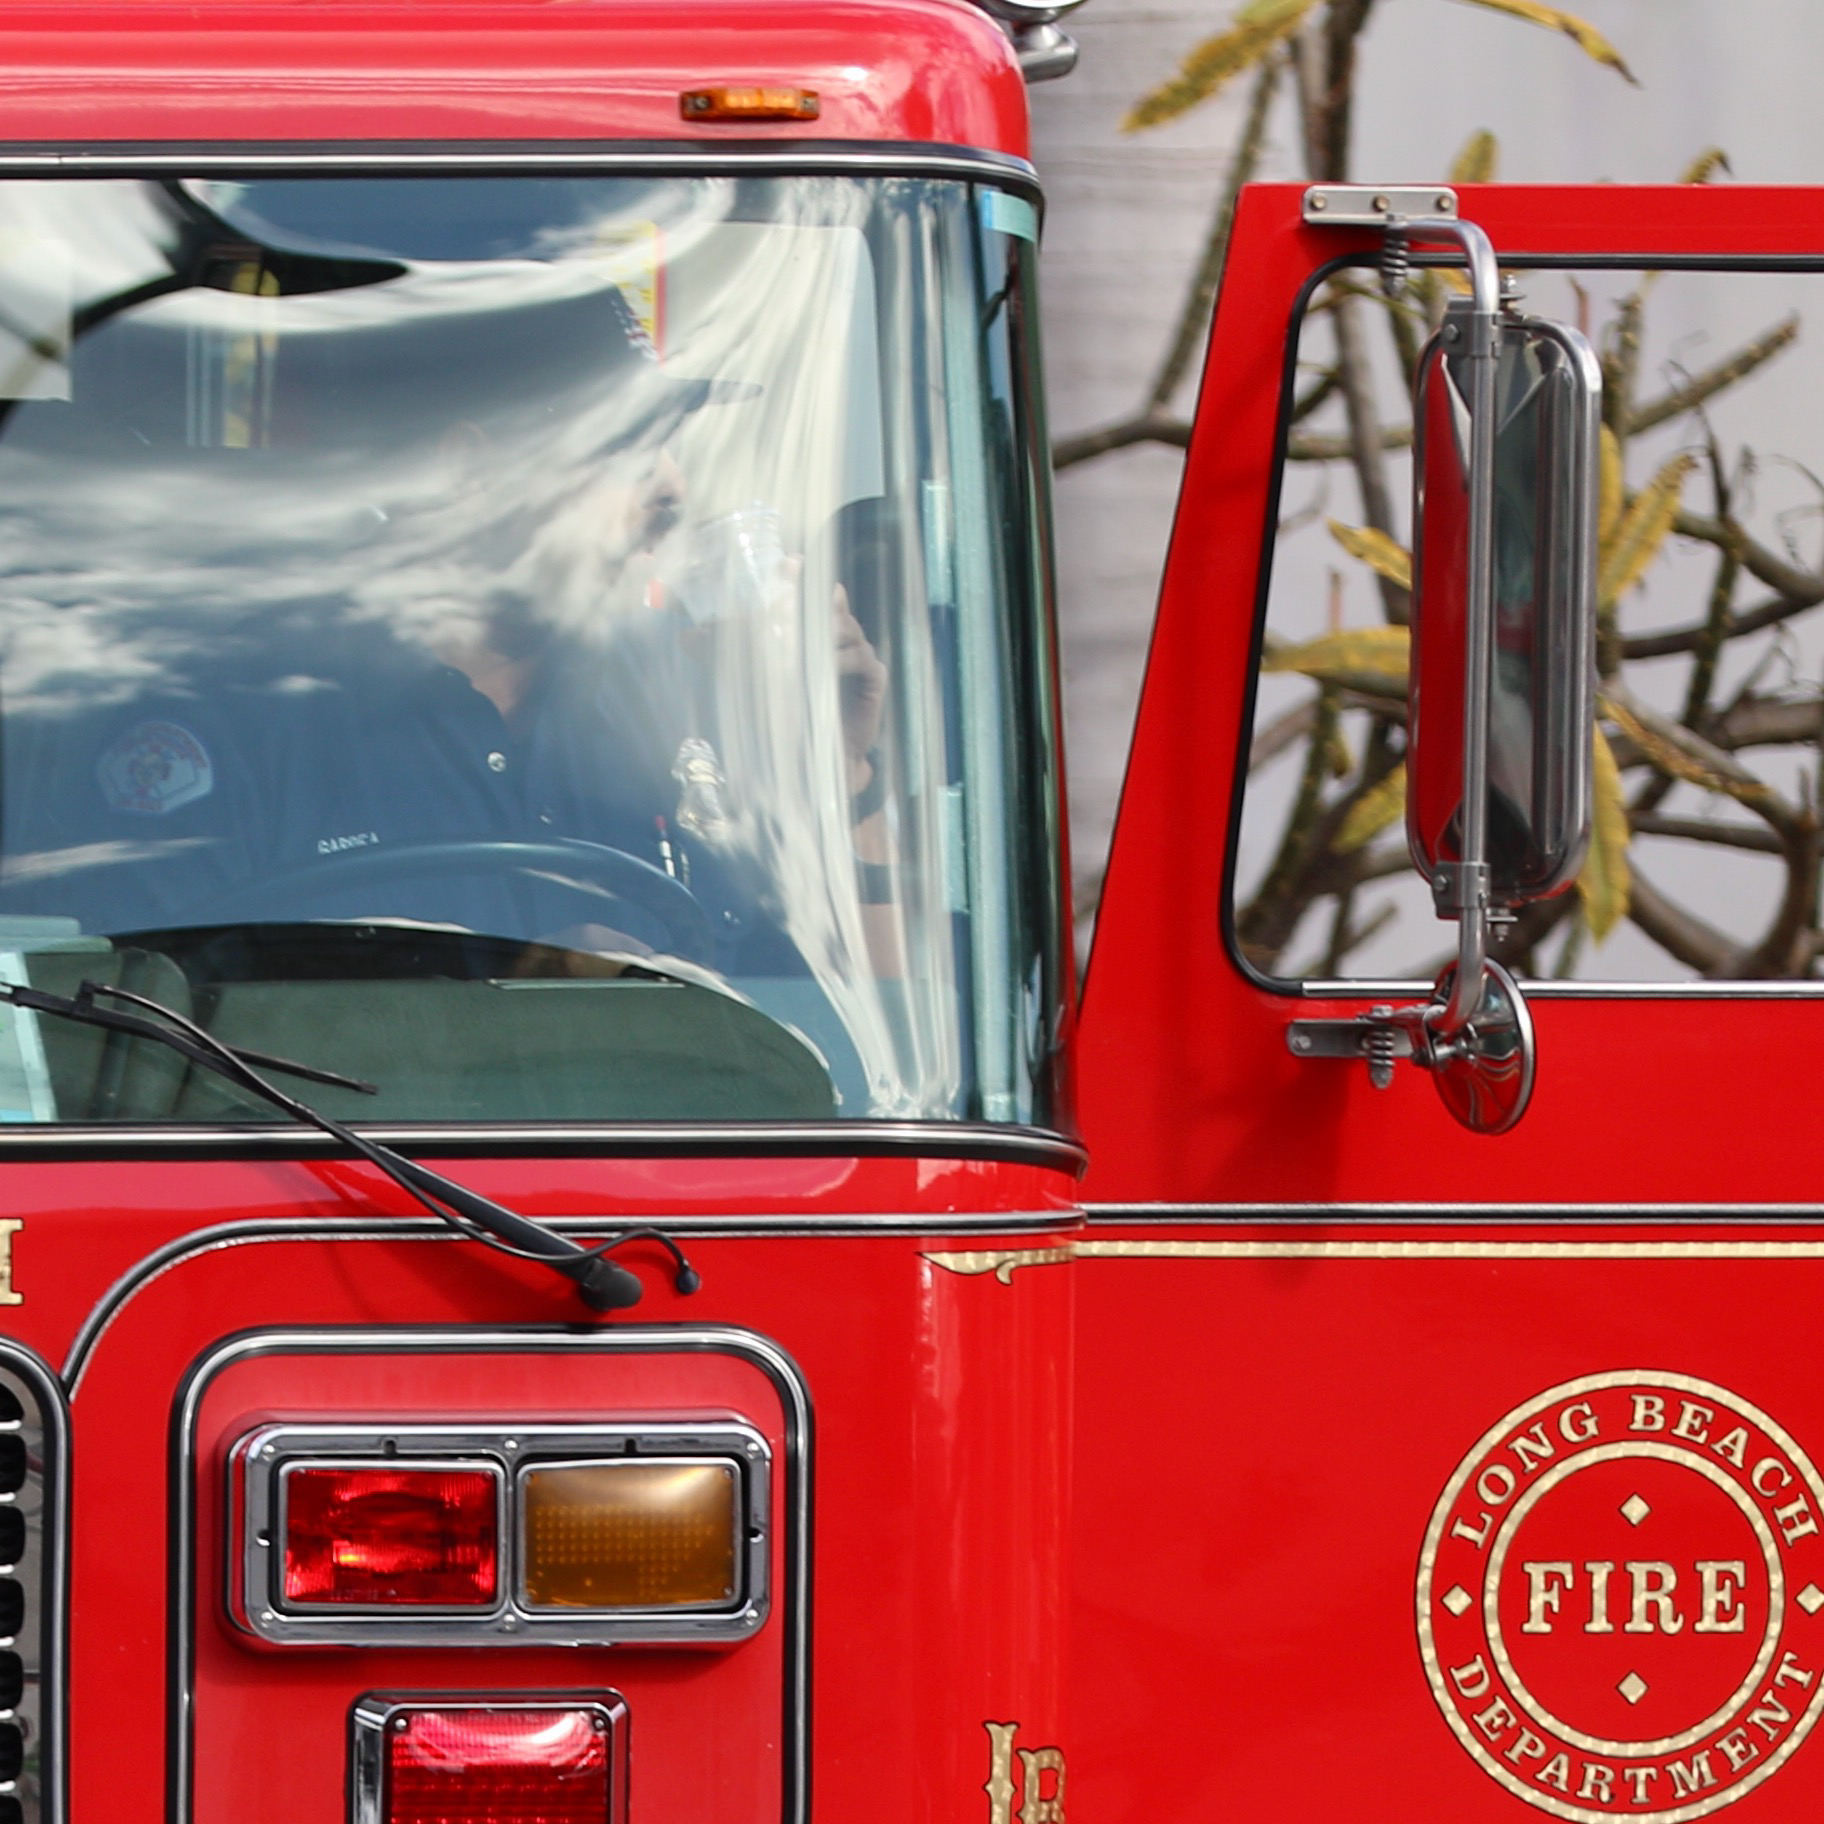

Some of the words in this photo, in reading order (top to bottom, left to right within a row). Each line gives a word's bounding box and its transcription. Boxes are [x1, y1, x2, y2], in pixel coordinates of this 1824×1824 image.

[1451, 1400, 1599, 1549] LONG
[1628, 1393, 1818, 1546] BEACH
[1520, 1560, 1747, 1635] FIRE
[1449, 1651, 1814, 1805] DEPARTMENT
